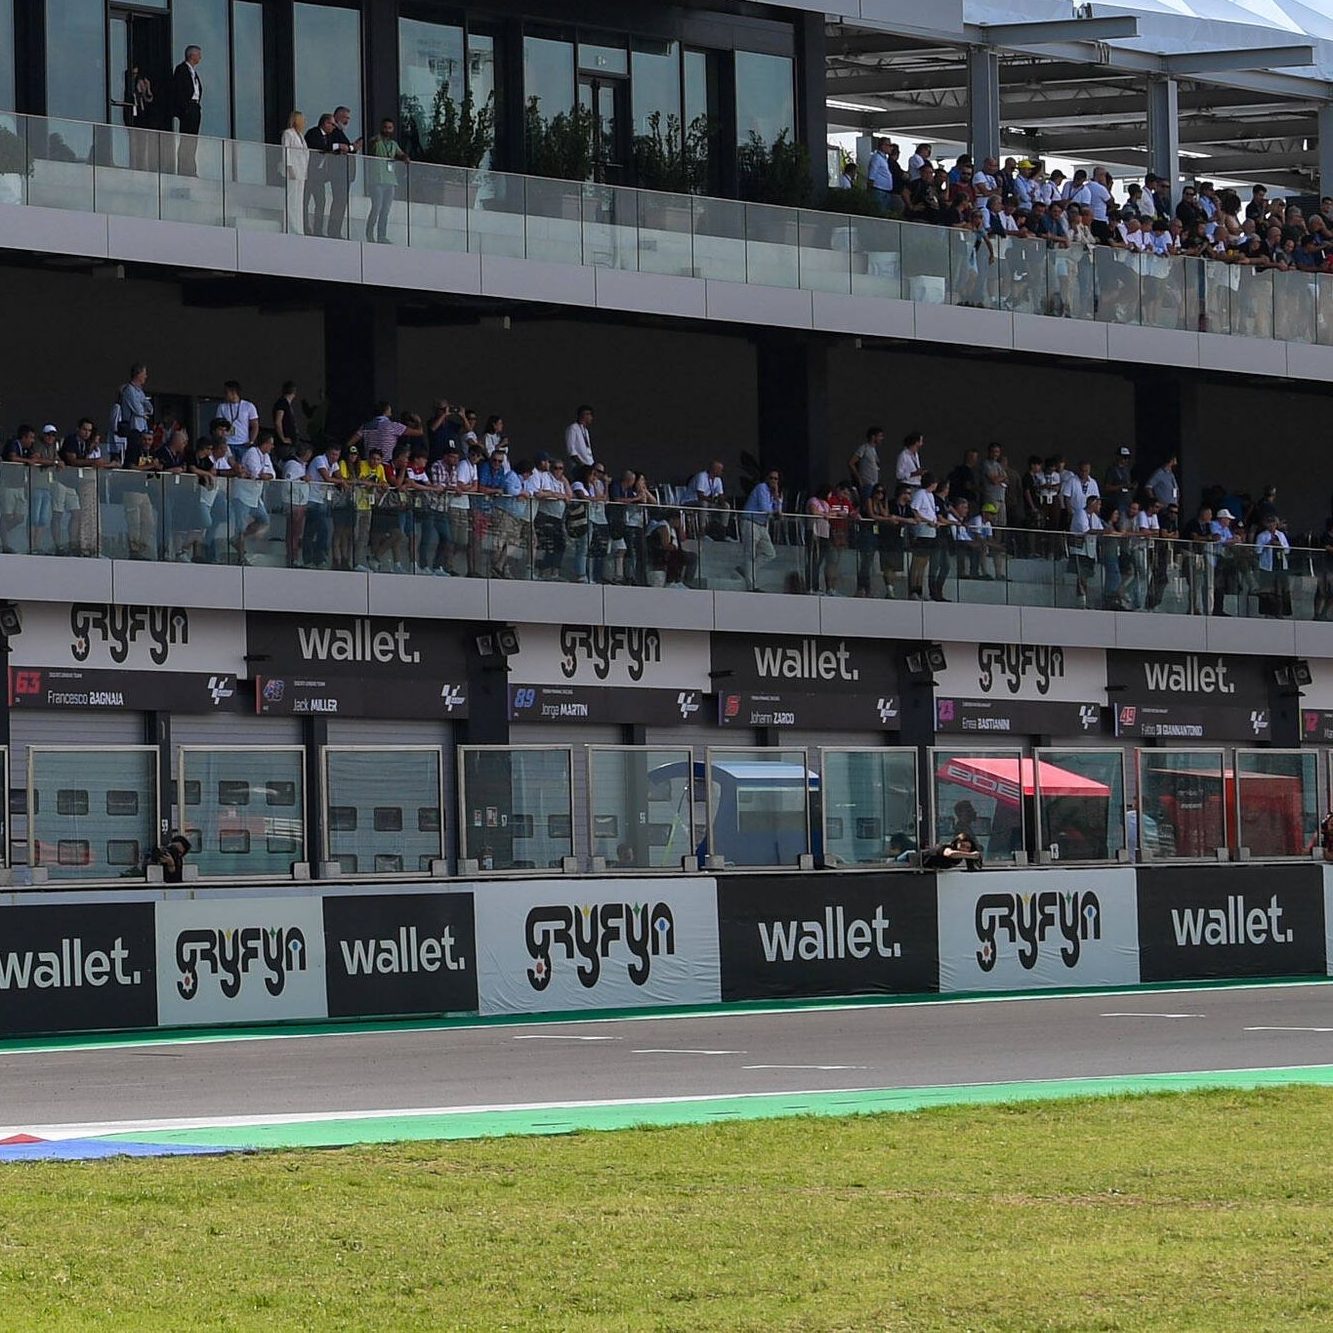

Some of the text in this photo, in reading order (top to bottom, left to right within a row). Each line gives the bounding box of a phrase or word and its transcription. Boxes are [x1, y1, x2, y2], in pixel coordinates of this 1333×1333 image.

[298, 618, 421, 663] wallet.
[754, 641, 859, 681] wallet.
[1144, 656, 1235, 694] wallet.
[16, 672, 41, 694] 63
[47, 690, 124, 705] Francesco BAGNAIA
[514, 688, 535, 708] 89
[293, 699, 337, 712] Jack MILLER
[560, 704, 588, 716] MARTIN
[758, 906, 901, 961] wallet.
[1172, 895, 1293, 945] wallet.
[340, 926, 465, 974] wallet.
